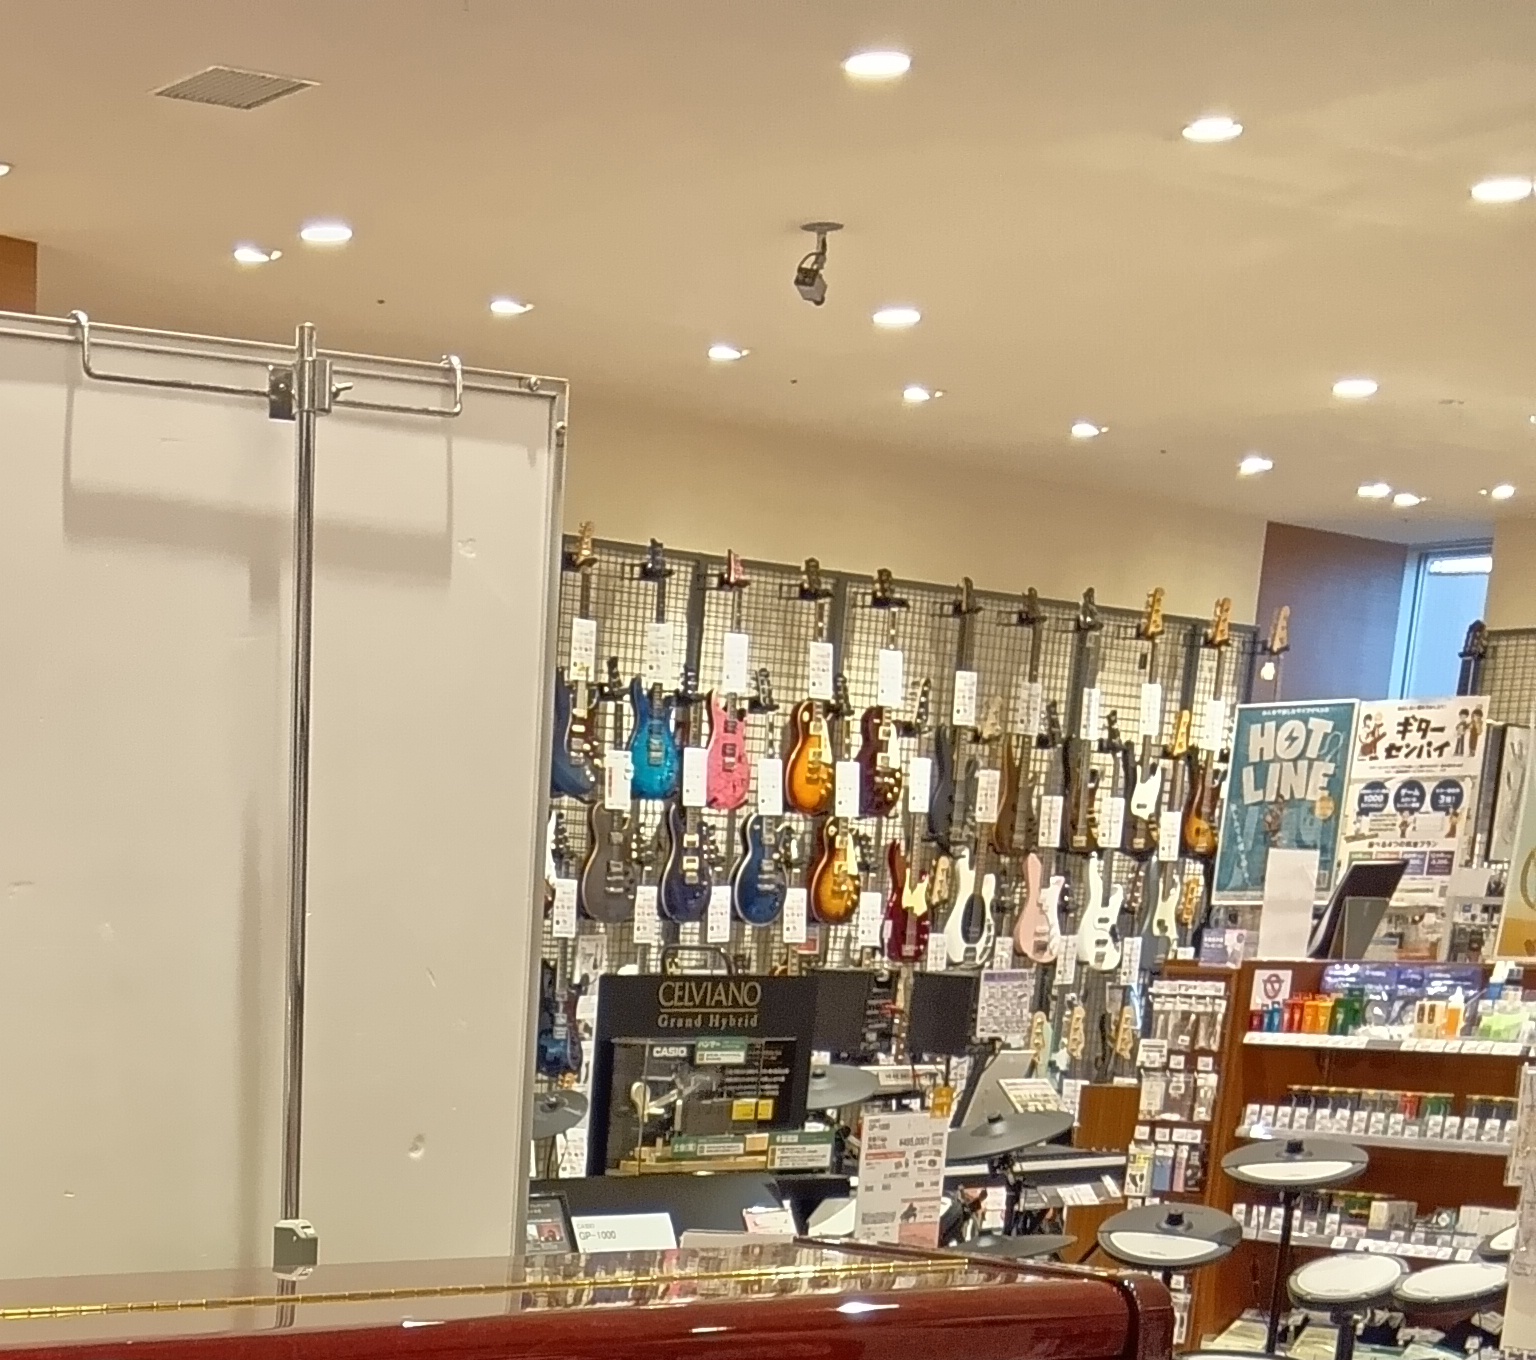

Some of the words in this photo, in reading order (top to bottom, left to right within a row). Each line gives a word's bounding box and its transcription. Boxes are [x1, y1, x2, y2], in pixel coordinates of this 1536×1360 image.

[1395, 715, 1446, 741] ギター
[1248, 717, 1335, 762] HOT
[1384, 741, 1451, 760] センパイ
[1242, 760, 1336, 805] LINE
[658, 981, 762, 1007] CELVIANO
[657, 1014, 703, 1028] Grand
[709, 1014, 758, 1030] Hybrid
[653, 1047, 687, 1057] CASIO
[578, 1230, 617, 1240] GP-1000
